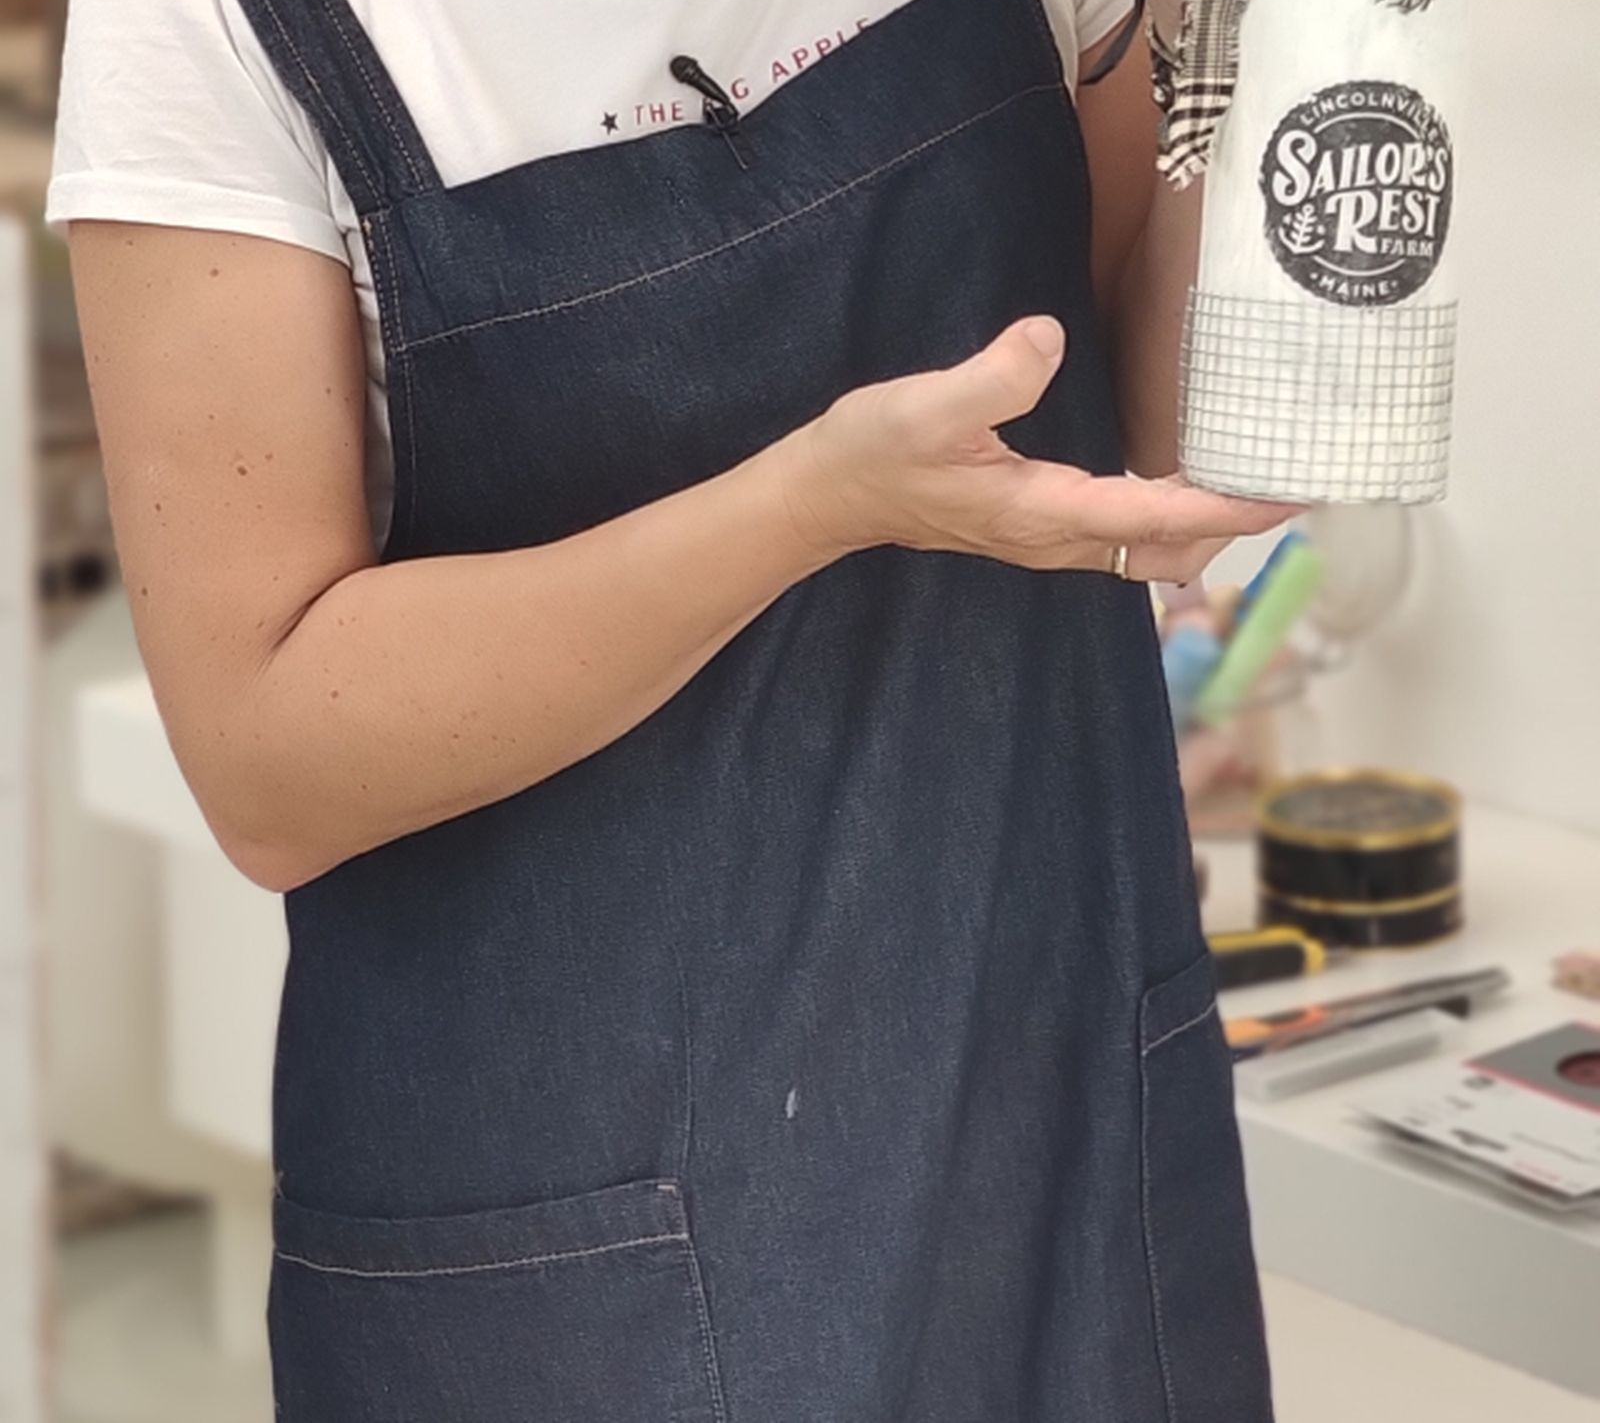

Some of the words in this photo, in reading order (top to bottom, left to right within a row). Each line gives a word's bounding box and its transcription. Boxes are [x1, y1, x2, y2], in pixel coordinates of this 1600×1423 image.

[634, 101, 684, 126] THE
[1300, 91, 1438, 142] LINCOLNVILLE
[1325, 189, 1441, 253] REST
[1380, 238, 1434, 257] FARM
[1318, 274, 1391, 299] MAINE
